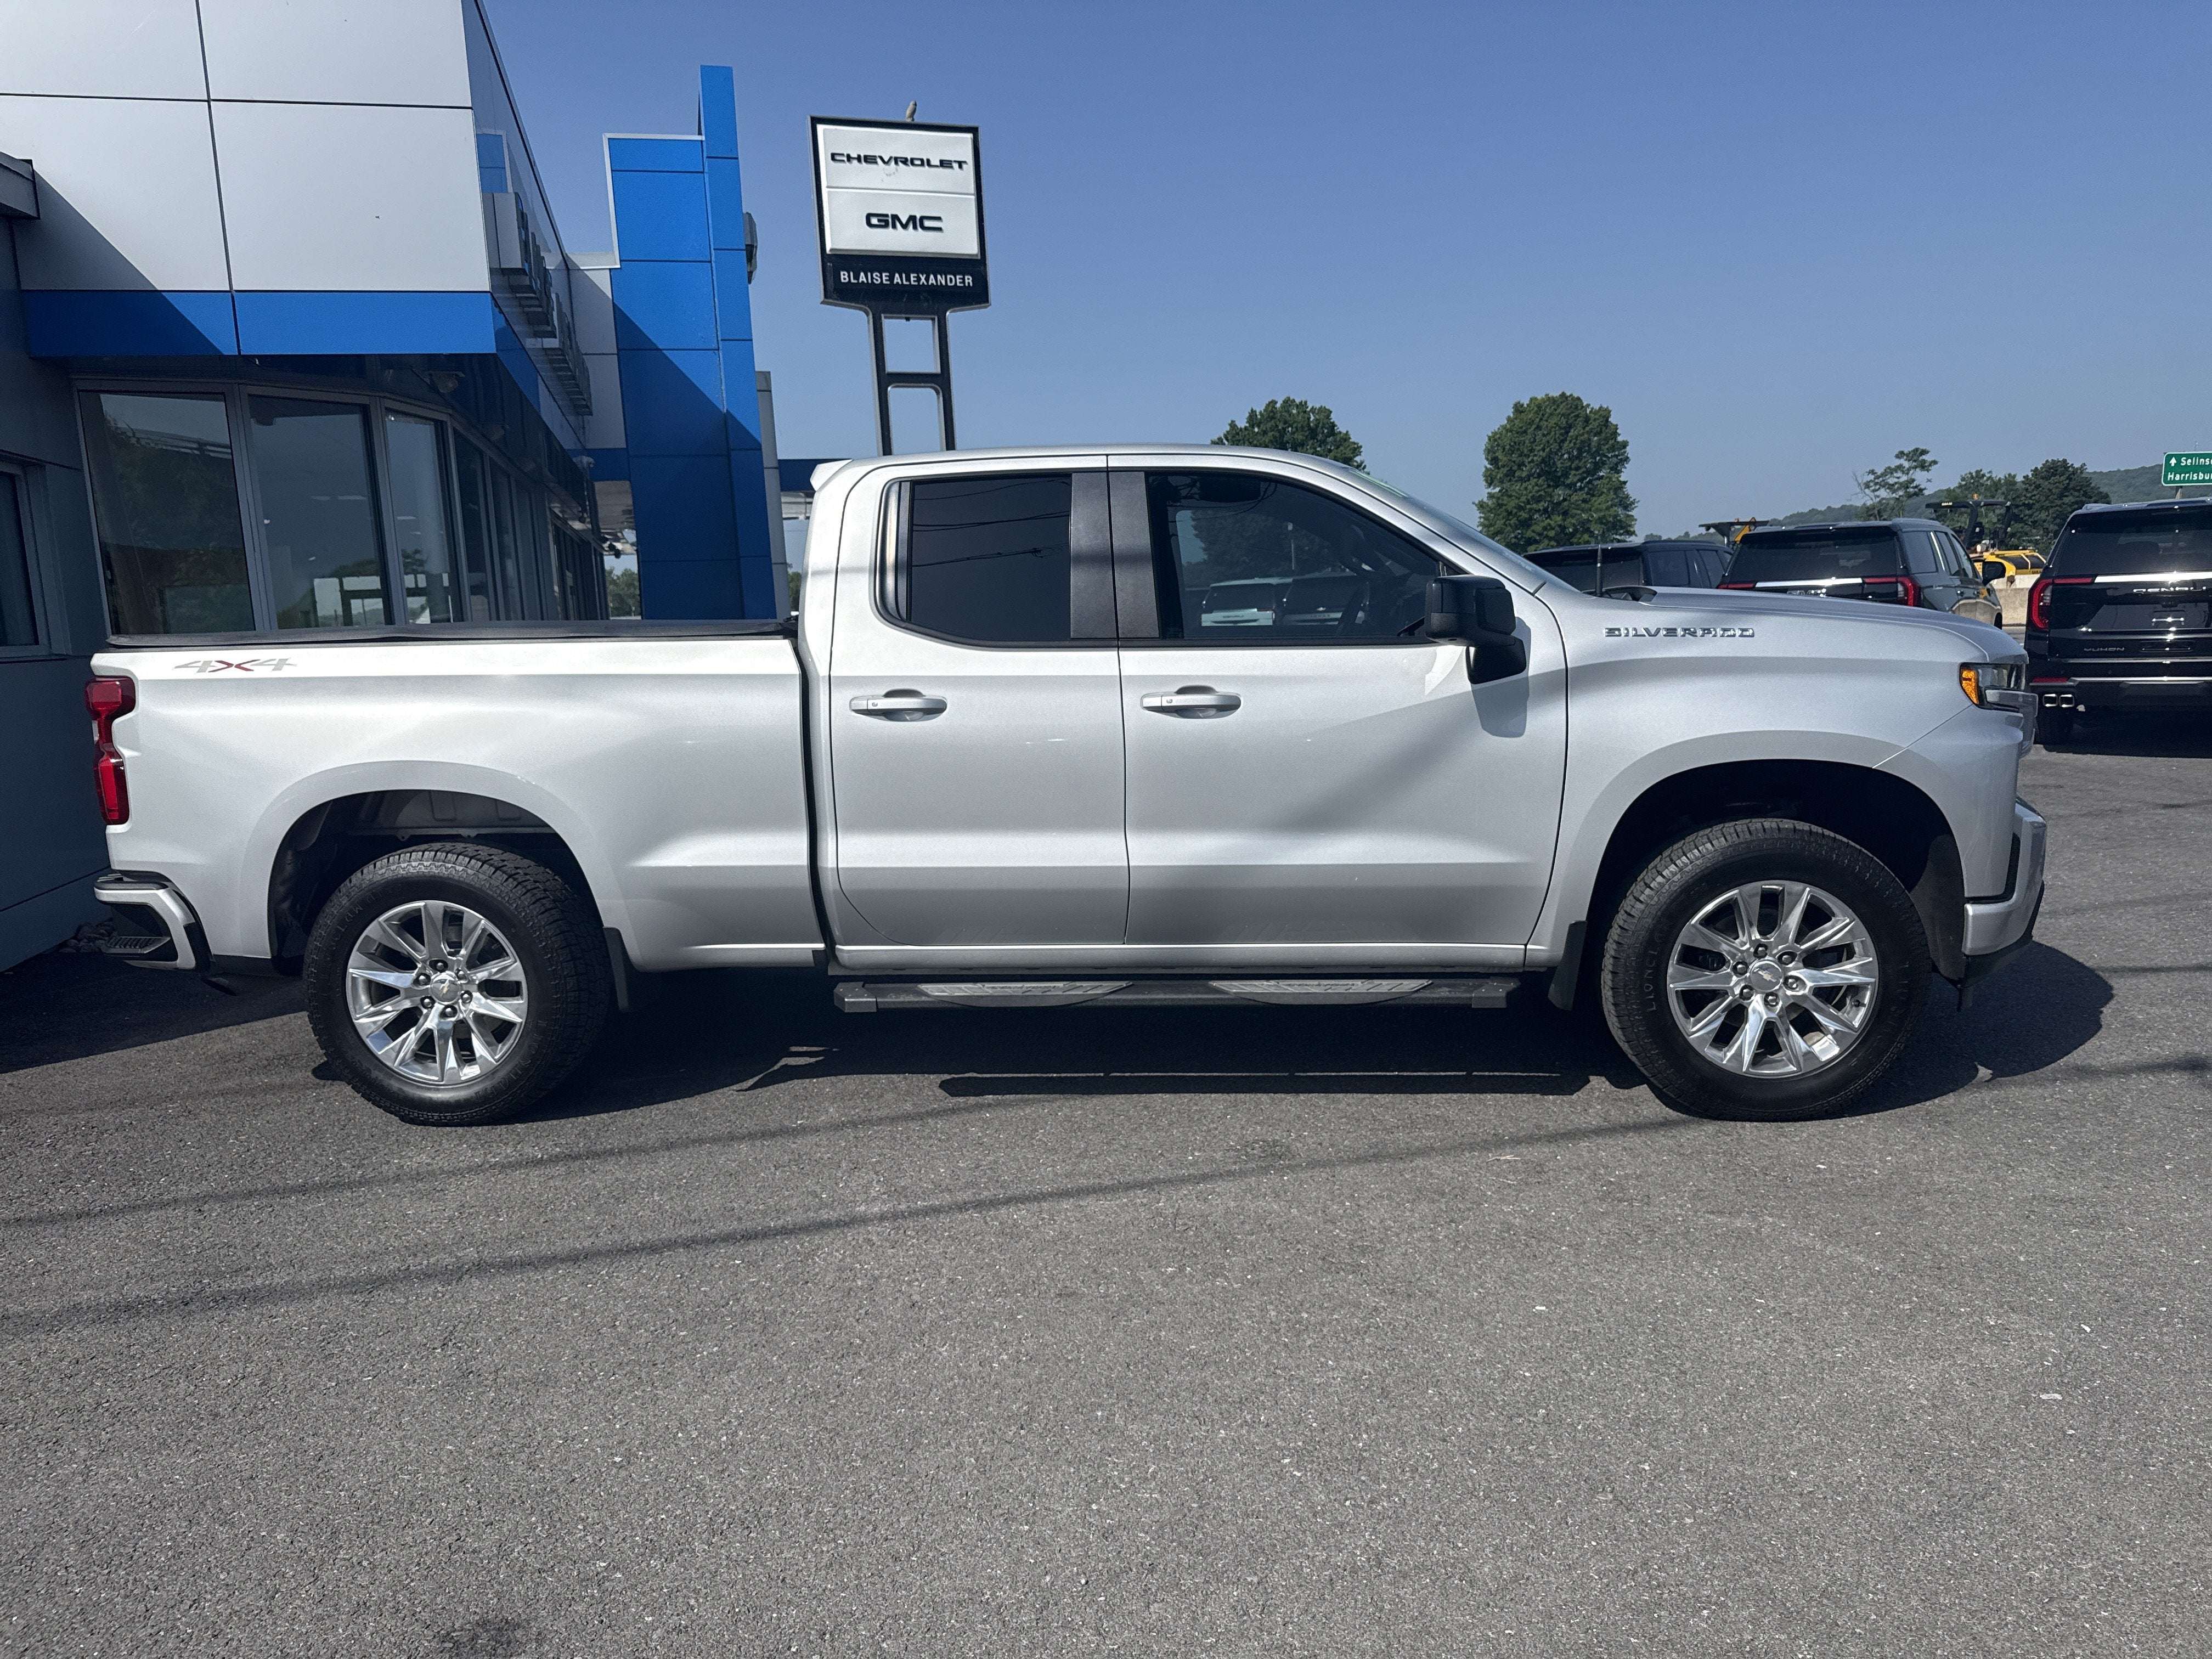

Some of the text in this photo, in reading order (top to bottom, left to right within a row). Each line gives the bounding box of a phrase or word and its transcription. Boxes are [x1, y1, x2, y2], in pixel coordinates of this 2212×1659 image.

[831, 153, 967, 170] CHEVROLET
[866, 213, 943, 232] GMC
[840, 270, 973, 287] BLAISE ALEXANDER
[1604, 628, 1754, 637] SILVERADO
